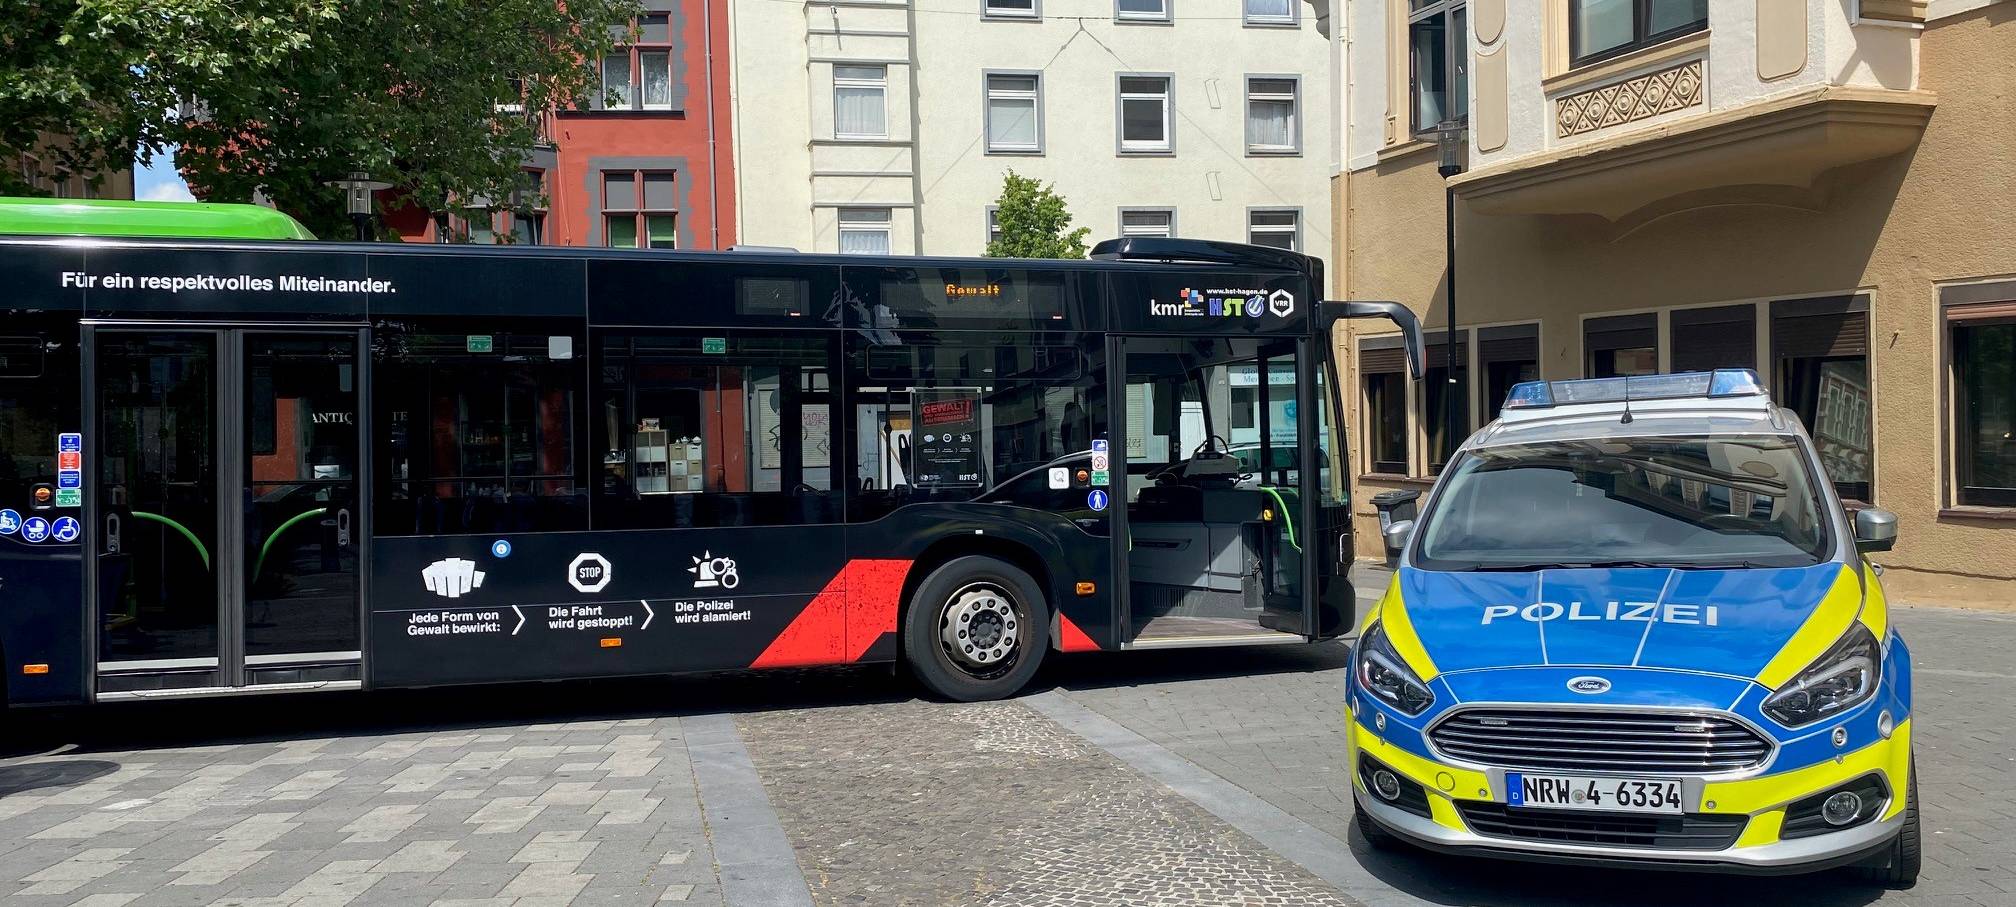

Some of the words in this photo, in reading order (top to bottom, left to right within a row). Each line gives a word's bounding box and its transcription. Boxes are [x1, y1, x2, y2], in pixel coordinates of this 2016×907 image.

[62, 271, 97, 289] Für
[102, 272, 134, 289] ein
[140, 274, 274, 294] respektvolles
[280, 275, 396, 293] Miteinander.
[946, 284, 1000, 295] Gewalt
[1151, 299, 1184, 316] kmr
[1209, 298, 1244, 316] HST
[579, 567, 601, 578] STOP
[549, 606, 570, 617] Die
[571, 605, 602, 616] Fahrt
[675, 601, 697, 612] Die
[697, 600, 734, 611] Polizei
[408, 613, 439, 624] Jede
[441, 611, 473, 622] Form
[476, 612, 499, 621] von
[675, 612, 700, 623] wird
[702, 610, 751, 622] alamiert!
[1481, 601, 1718, 626] POLIZEI
[407, 624, 450, 636] Gewalt
[452, 622, 501, 634] bewirkt:
[549, 617, 574, 629] wird
[577, 615, 633, 630] gestoppt!
[1577, 681, 1600, 690] Ford
[1512, 792, 1519, 800] D
[1523, 777, 1570, 804] NRW
[1586, 780, 1681, 808] 4-6334
